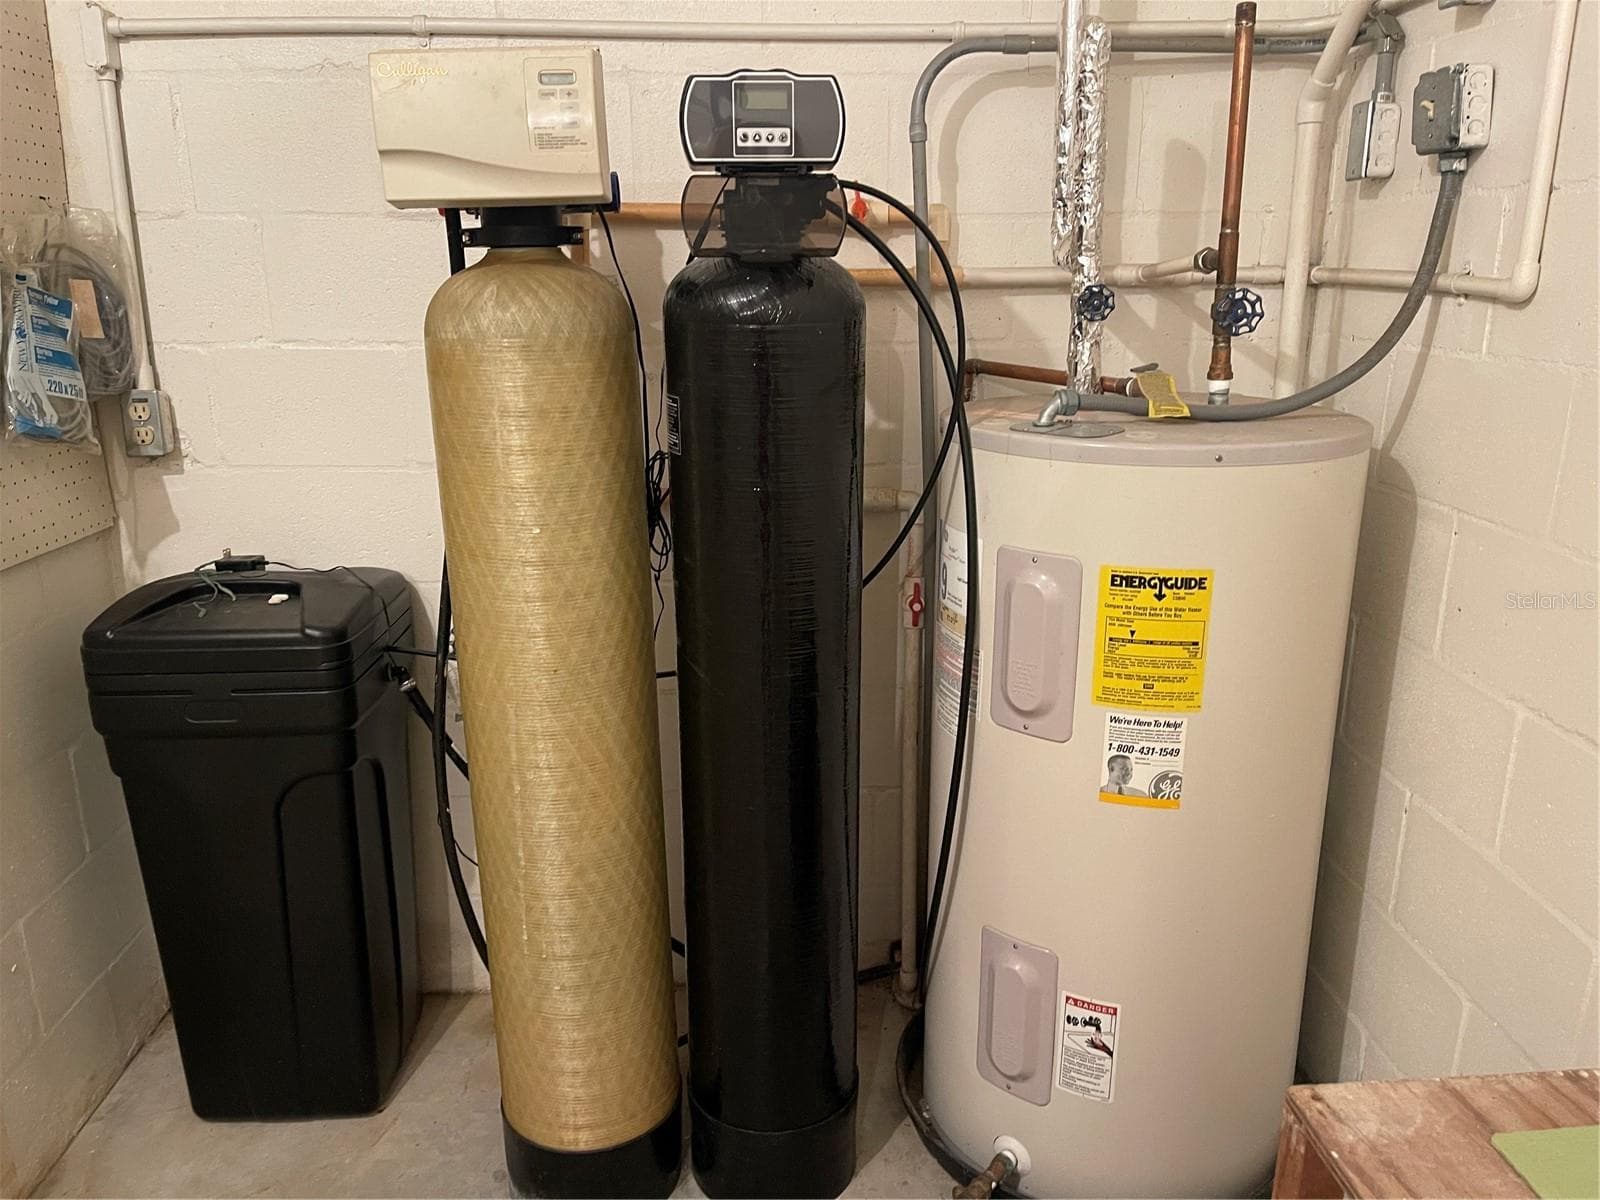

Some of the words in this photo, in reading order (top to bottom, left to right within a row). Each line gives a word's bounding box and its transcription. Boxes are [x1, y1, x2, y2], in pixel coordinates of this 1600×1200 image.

[1110, 574, 1208, 592] ENERGYGUIDE
[1104, 602, 1123, 610] Compare
[1109, 715, 1133, 726] We're
[1133, 718, 1153, 728] Here
[1153, 719, 1162, 728] To
[1162, 720, 1184, 731] Help!
[1108, 742, 1181, 758] 1-800-431-1549
[1077, 1000, 1115, 1014] DANGER
